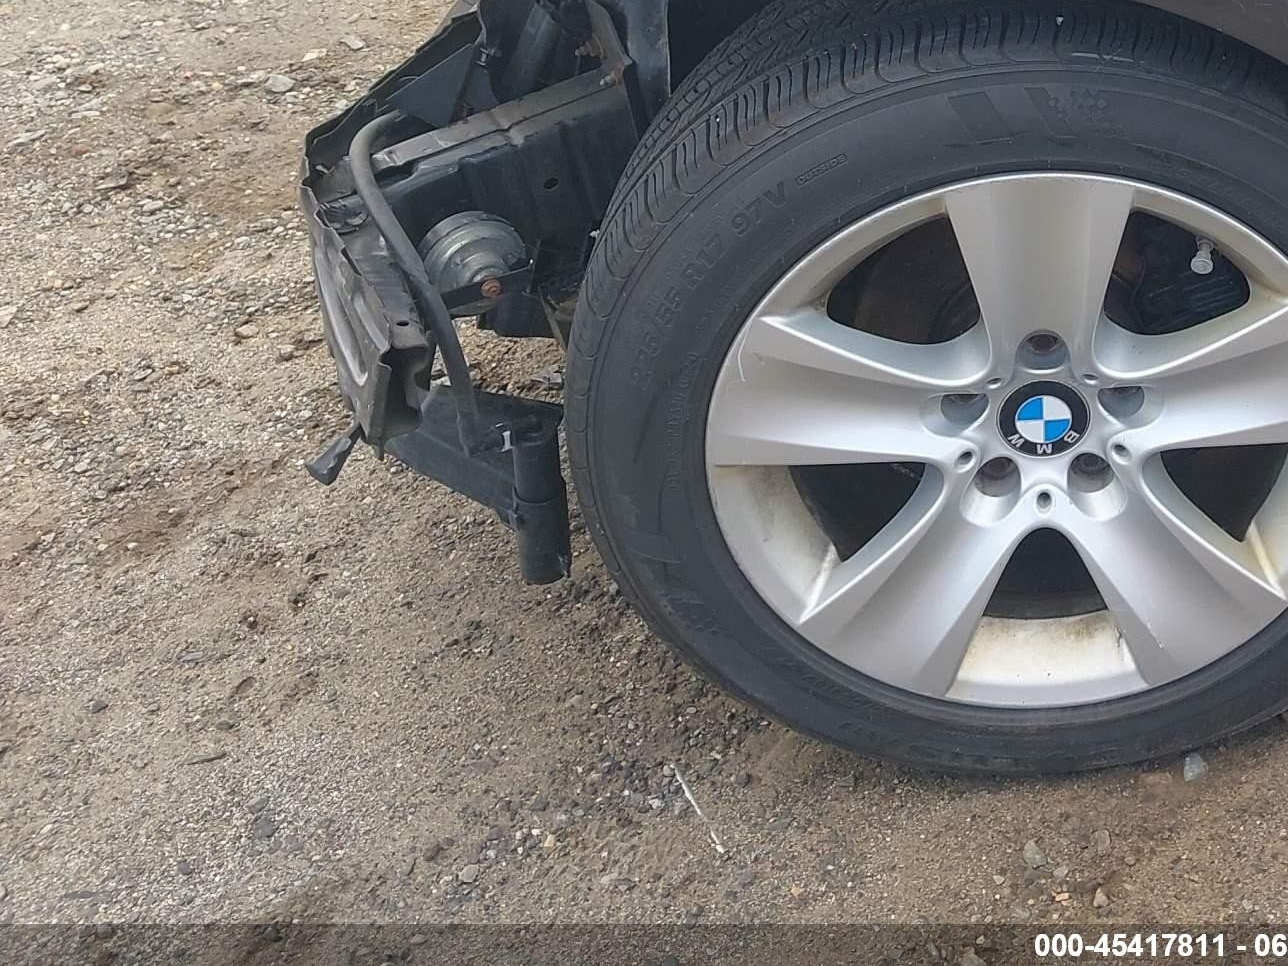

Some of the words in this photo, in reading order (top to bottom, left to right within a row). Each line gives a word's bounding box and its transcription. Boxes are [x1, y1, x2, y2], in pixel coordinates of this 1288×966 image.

[794, 153, 849, 187] OUTSIDE
[679, 236, 726, 290] R17
[729, 180, 788, 238] 97V
[1007, 429, 1081, 455] BMW
